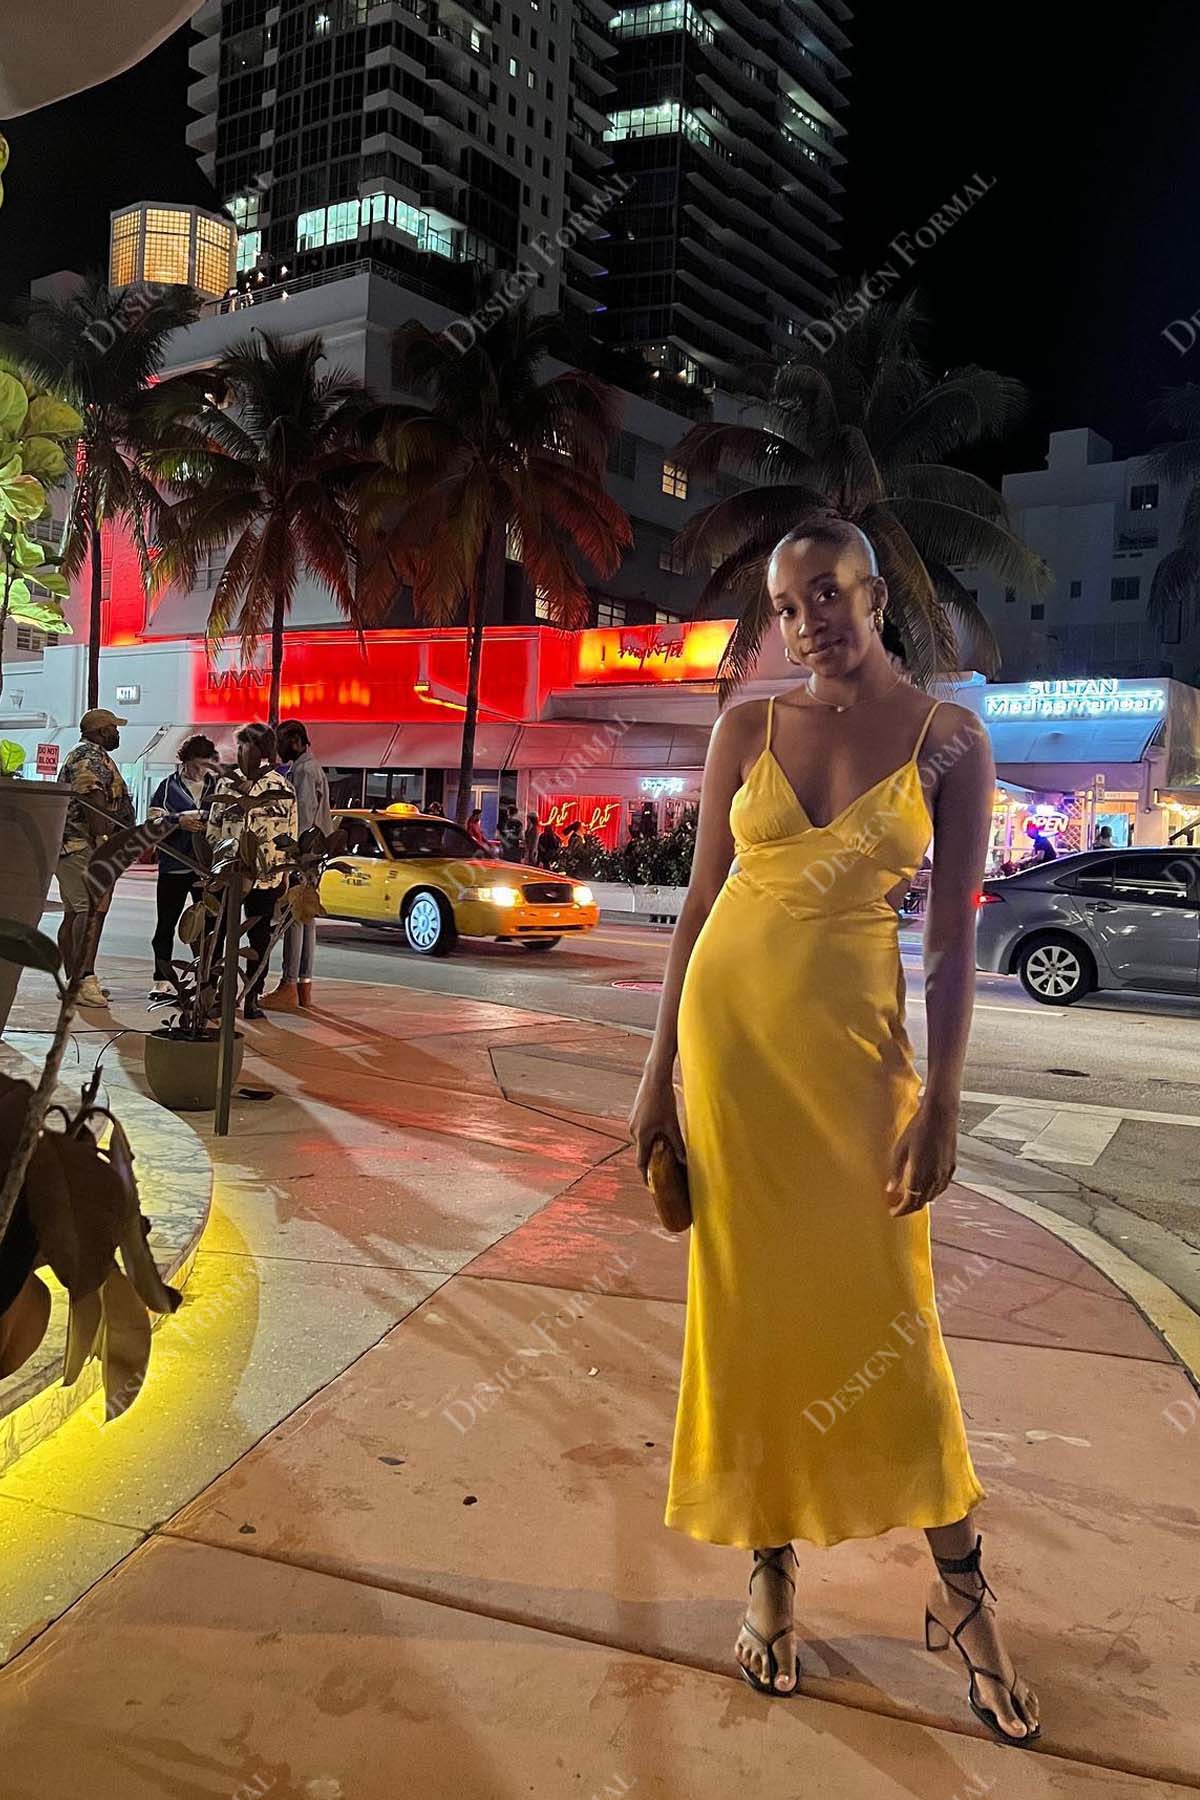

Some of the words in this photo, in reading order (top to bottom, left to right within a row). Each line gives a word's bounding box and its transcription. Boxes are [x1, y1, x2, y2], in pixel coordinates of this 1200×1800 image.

[1027, 679, 1118, 695] SULTAN
[47, 747, 58, 755] NOT
[1023, 816, 1069, 833] OPEN
